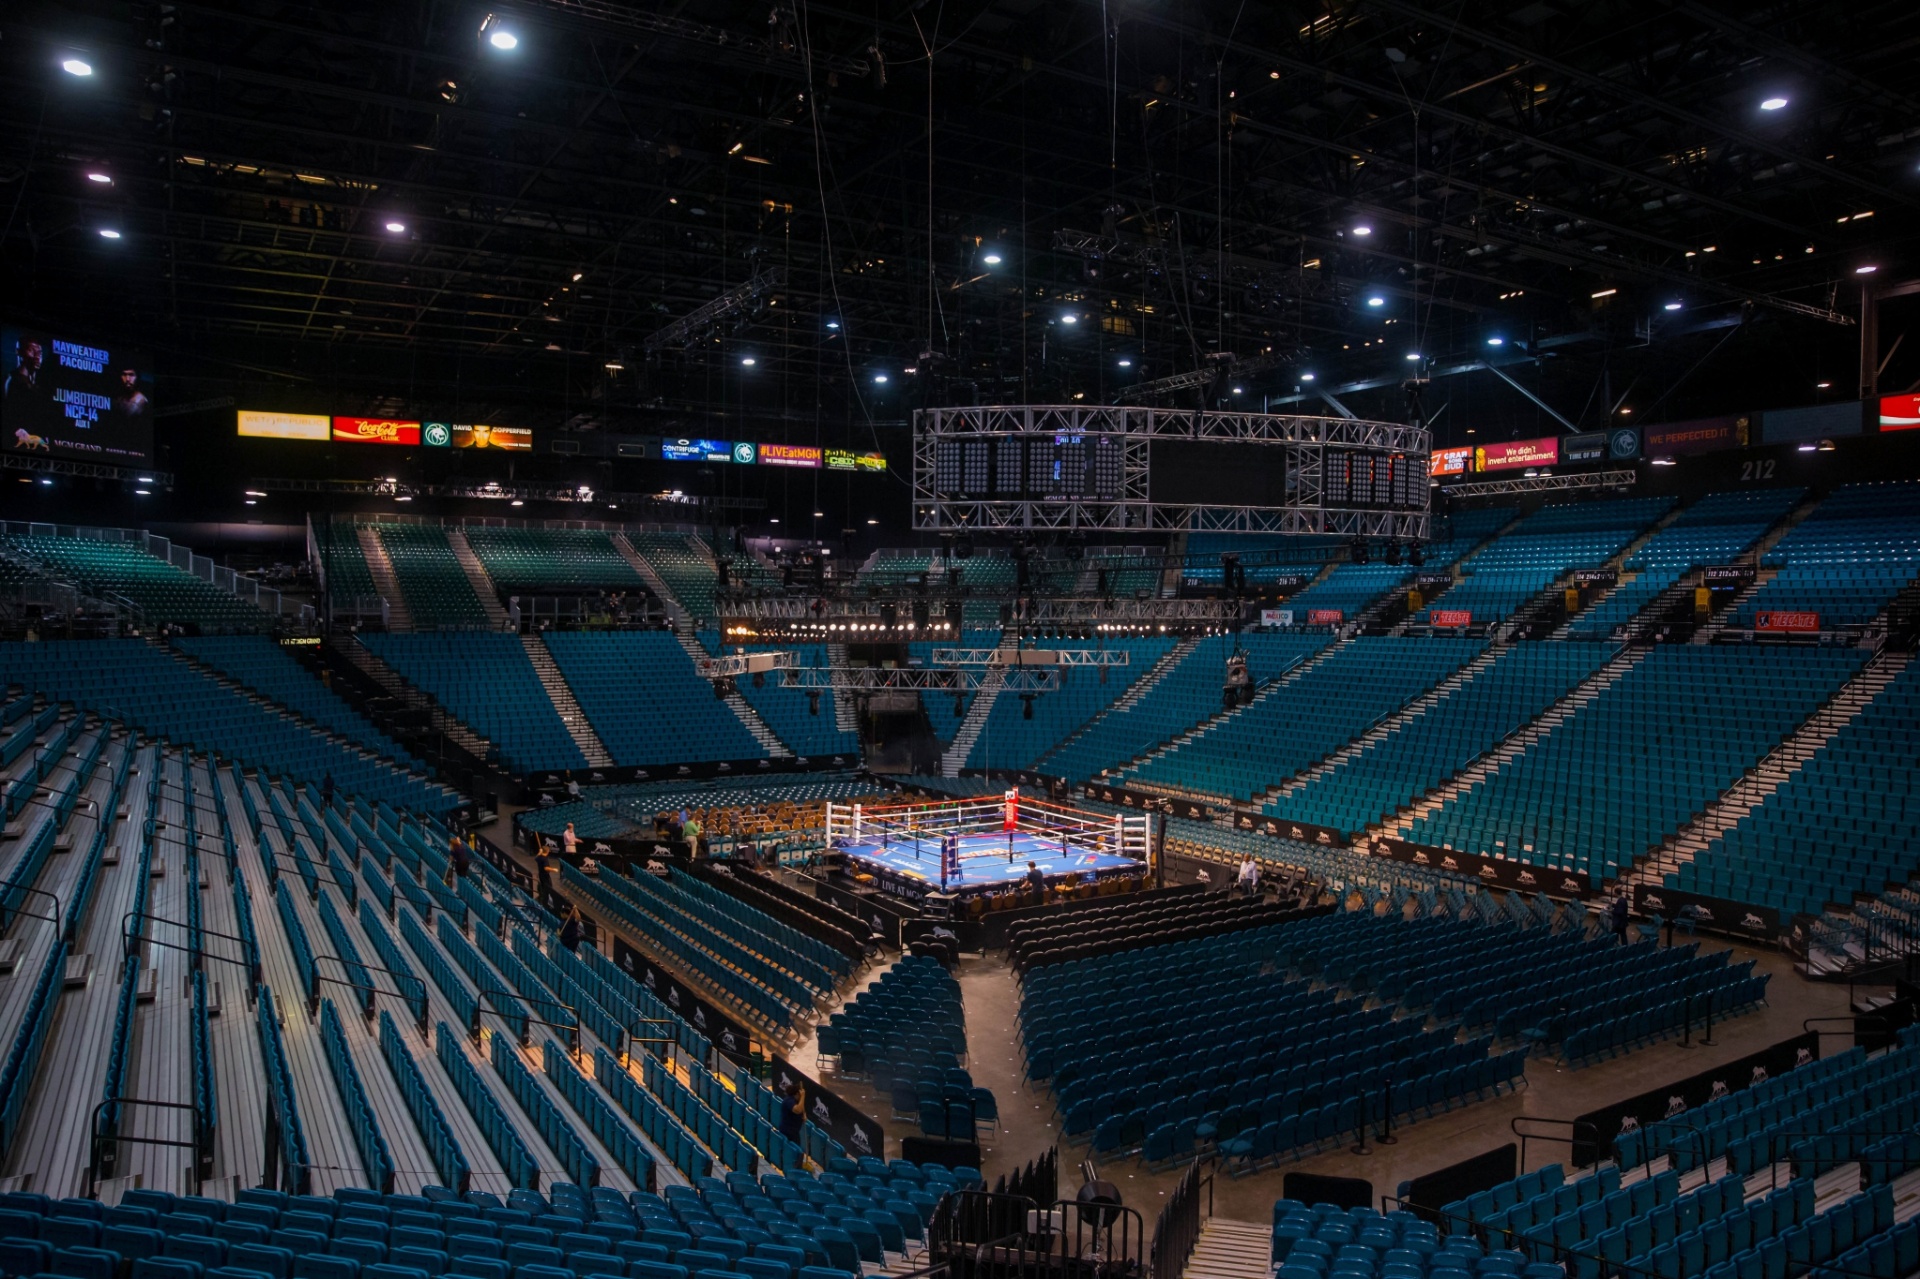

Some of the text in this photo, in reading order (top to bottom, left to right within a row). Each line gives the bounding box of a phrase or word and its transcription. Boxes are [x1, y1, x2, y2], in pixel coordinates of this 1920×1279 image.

[53, 340, 109, 361] MAYWEATHER
[60, 355, 103, 374] PACQUIAO
[53, 387, 111, 411] JUMBOTRON
[65, 403, 99, 422] NCP-14
[358, 421, 398, 436] Coca-Cola
[493, 427, 532, 435] COPPERFIELD
[1649, 435, 1663, 445] WE
[1665, 429, 1718, 443] PERFECTED
[54, 439, 74, 448] MGM
[74, 441, 102, 452] GRAND
[760, 445, 821, 460] #LIVEatMGM
[1506, 446, 1536, 456] We didn't
[1487, 451, 1556, 465] invent entertainment.
[1740, 459, 1776, 481] 212
[1317, 611, 1342, 622] TECATE
[1441, 612, 1471, 624] TECATE
[1771, 613, 1817, 628] TECATE
[882, 879, 896, 893] LIVE
[897, 886, 906, 896] AT
